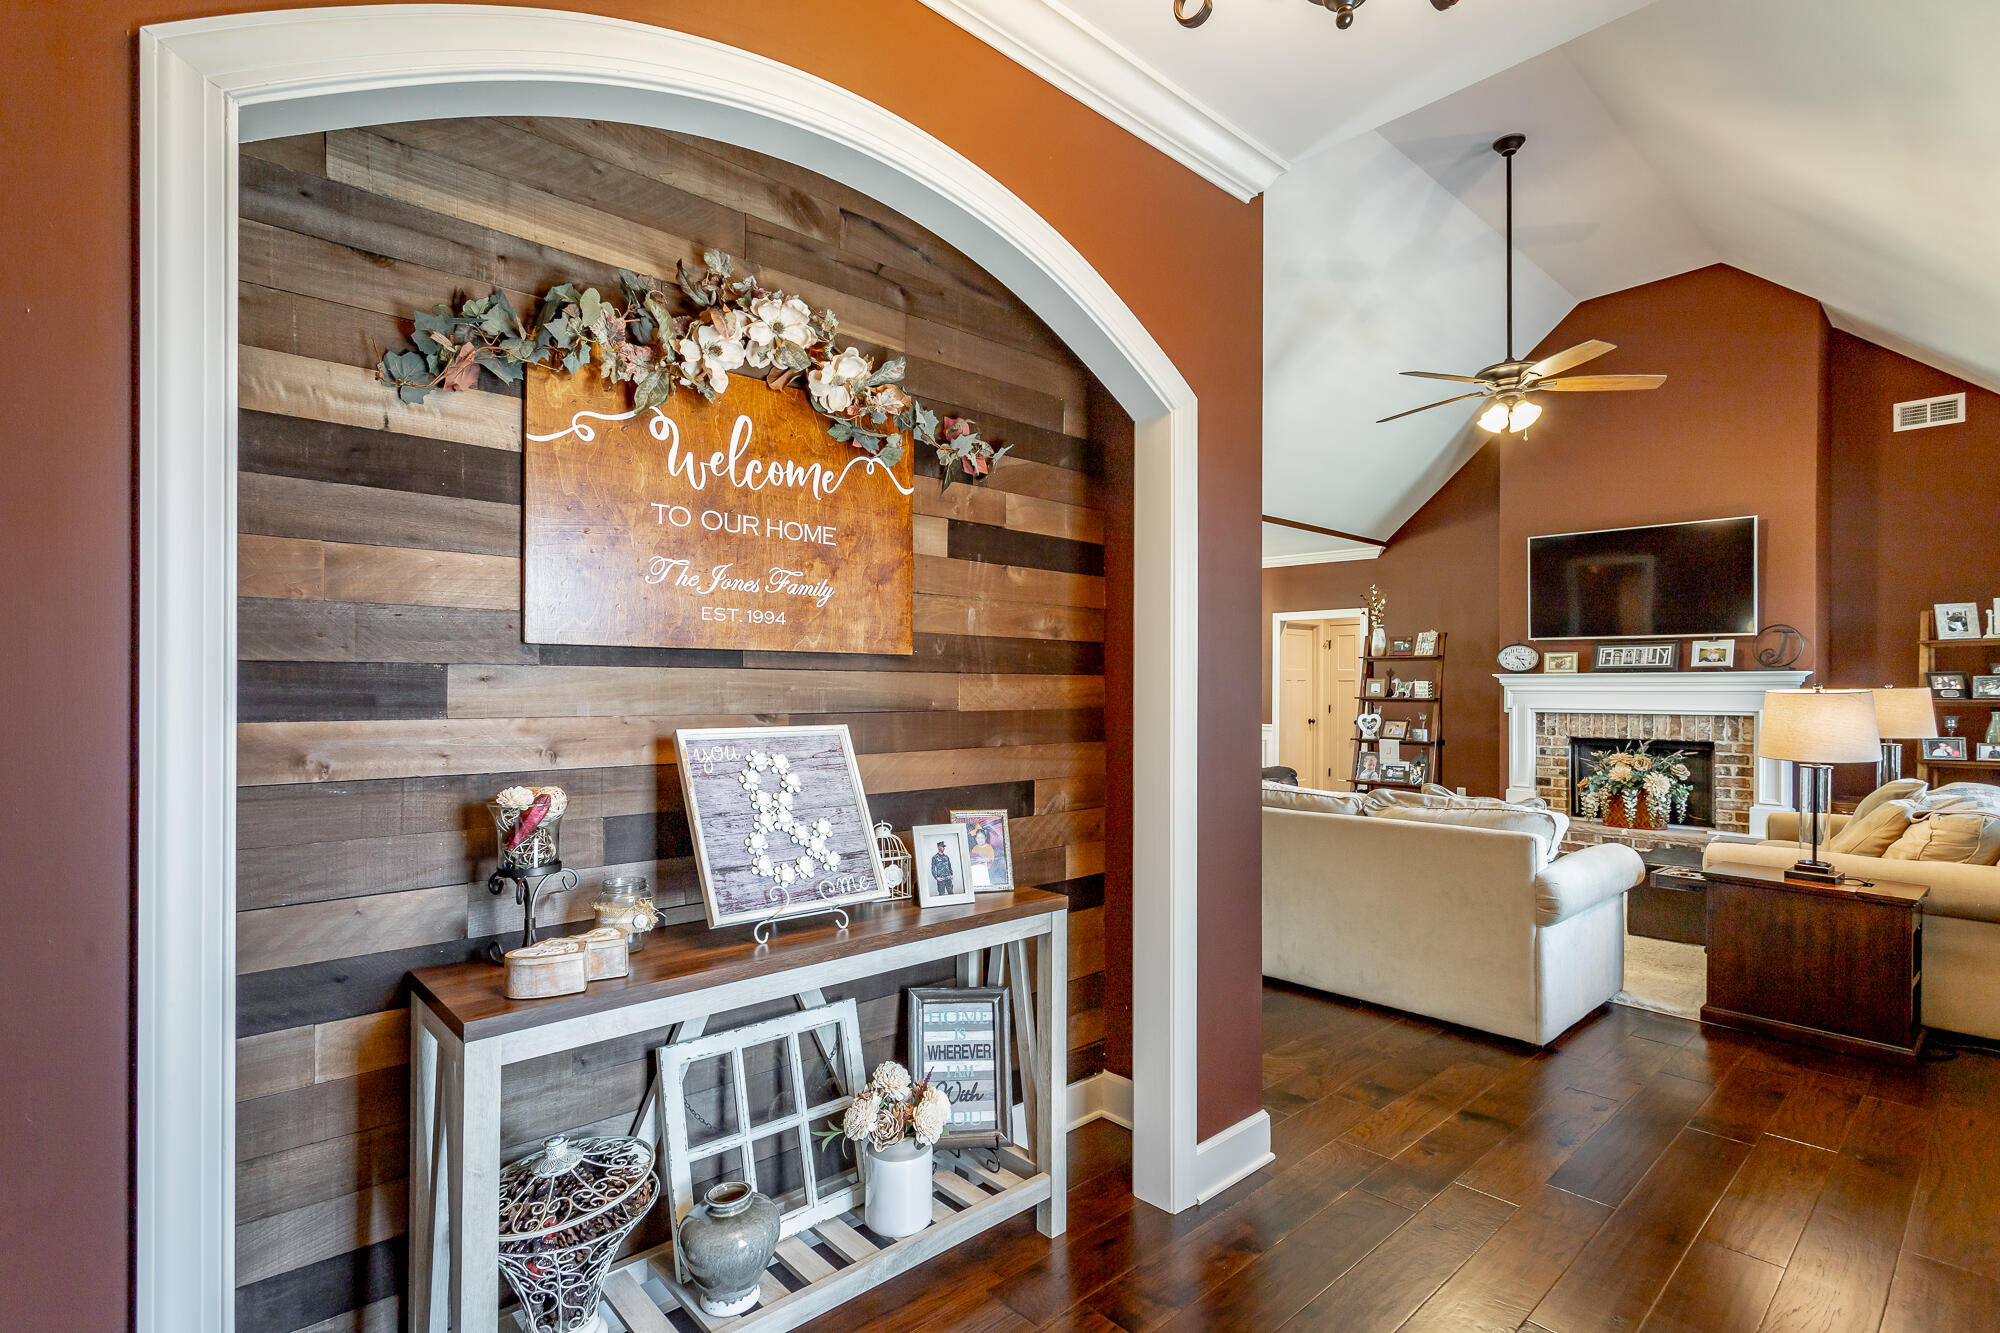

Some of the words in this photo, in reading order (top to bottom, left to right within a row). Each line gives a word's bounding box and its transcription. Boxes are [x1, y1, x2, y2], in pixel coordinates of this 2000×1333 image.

[649, 406, 839, 500] Welcome
[650, 502, 692, 527] TO
[700, 509, 759, 536] OUR
[766, 519, 837, 545] HOME
[645, 555, 700, 587] The
[697, 563, 761, 594] Jones
[765, 566, 835, 608] Family
[701, 606, 743, 622] EST.
[746, 609, 786, 625] 1994
[693, 745, 741, 774] you
[836, 875, 870, 893] me
[928, 1009, 990, 1025] HOME
[954, 1027, 967, 1041] IS
[927, 1044, 991, 1060] WHEREVER
[946, 1065, 951, 1078] I
[953, 1064, 975, 1078] AM
[935, 1080, 985, 1105] With
[950, 1109, 982, 1127] OU
